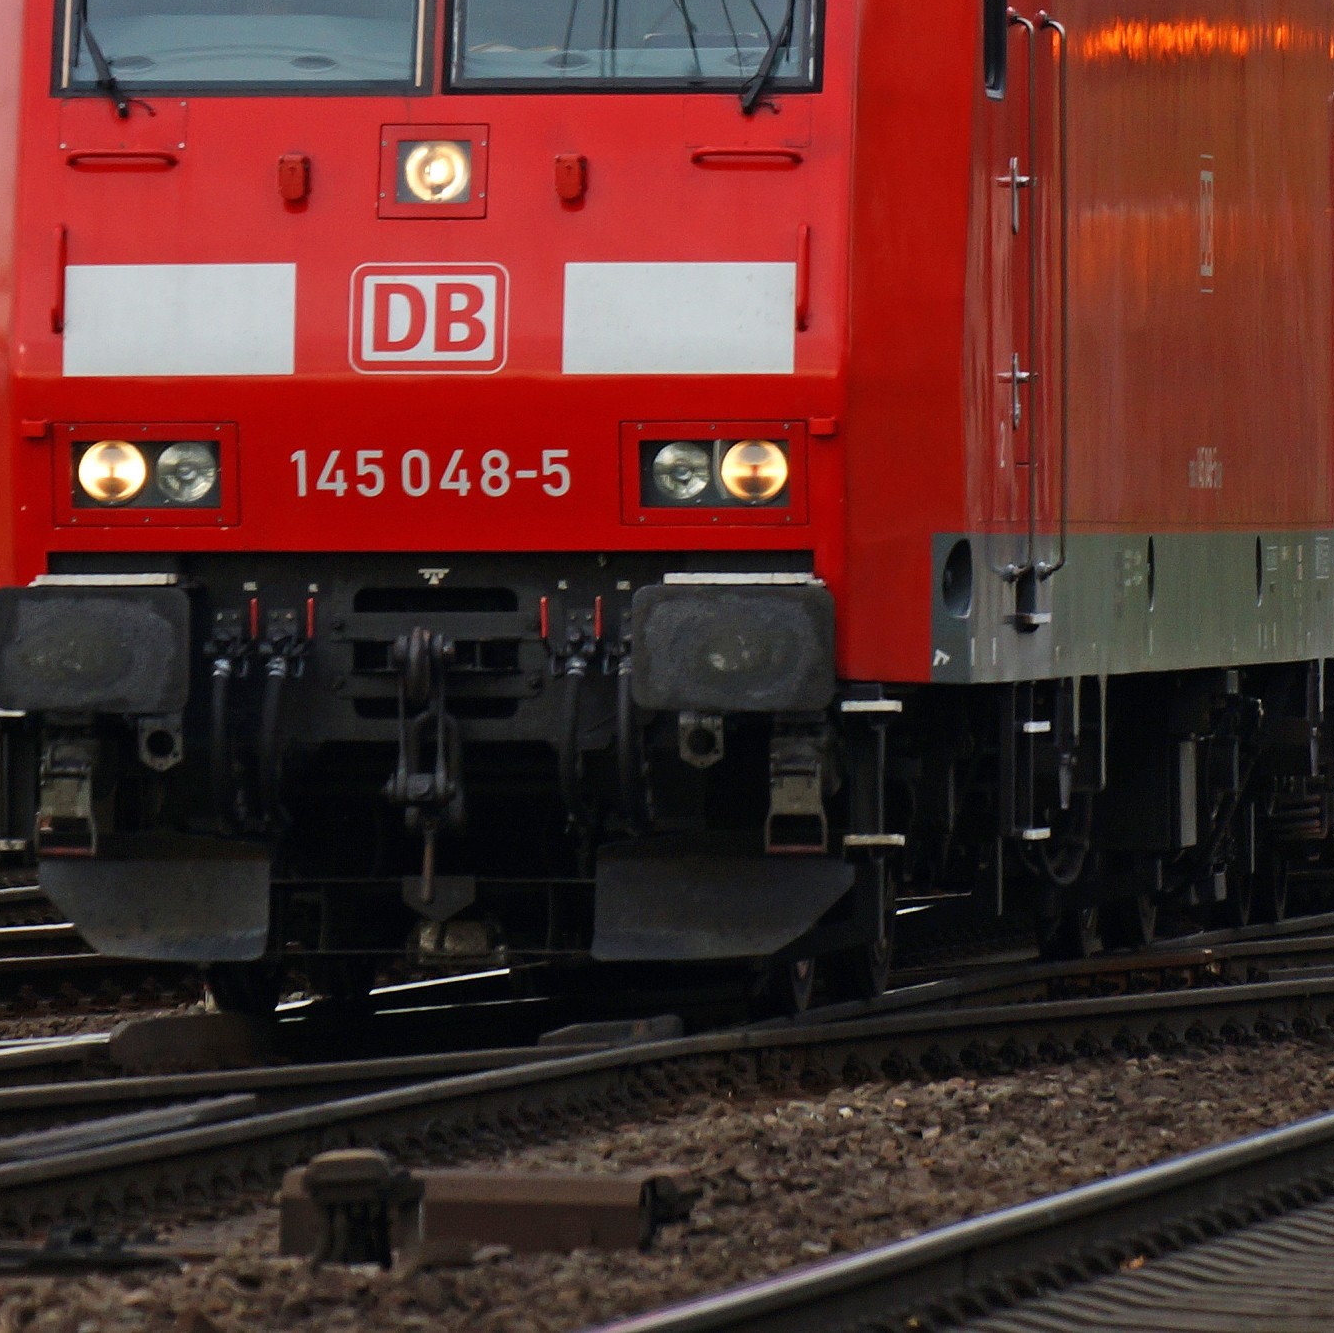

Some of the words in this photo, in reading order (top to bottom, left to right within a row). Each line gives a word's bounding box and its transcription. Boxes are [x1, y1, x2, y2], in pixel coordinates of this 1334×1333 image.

[372, 282, 486, 353] DB
[289, 448, 386, 498] 145
[400, 448, 572, 498] 048-5
